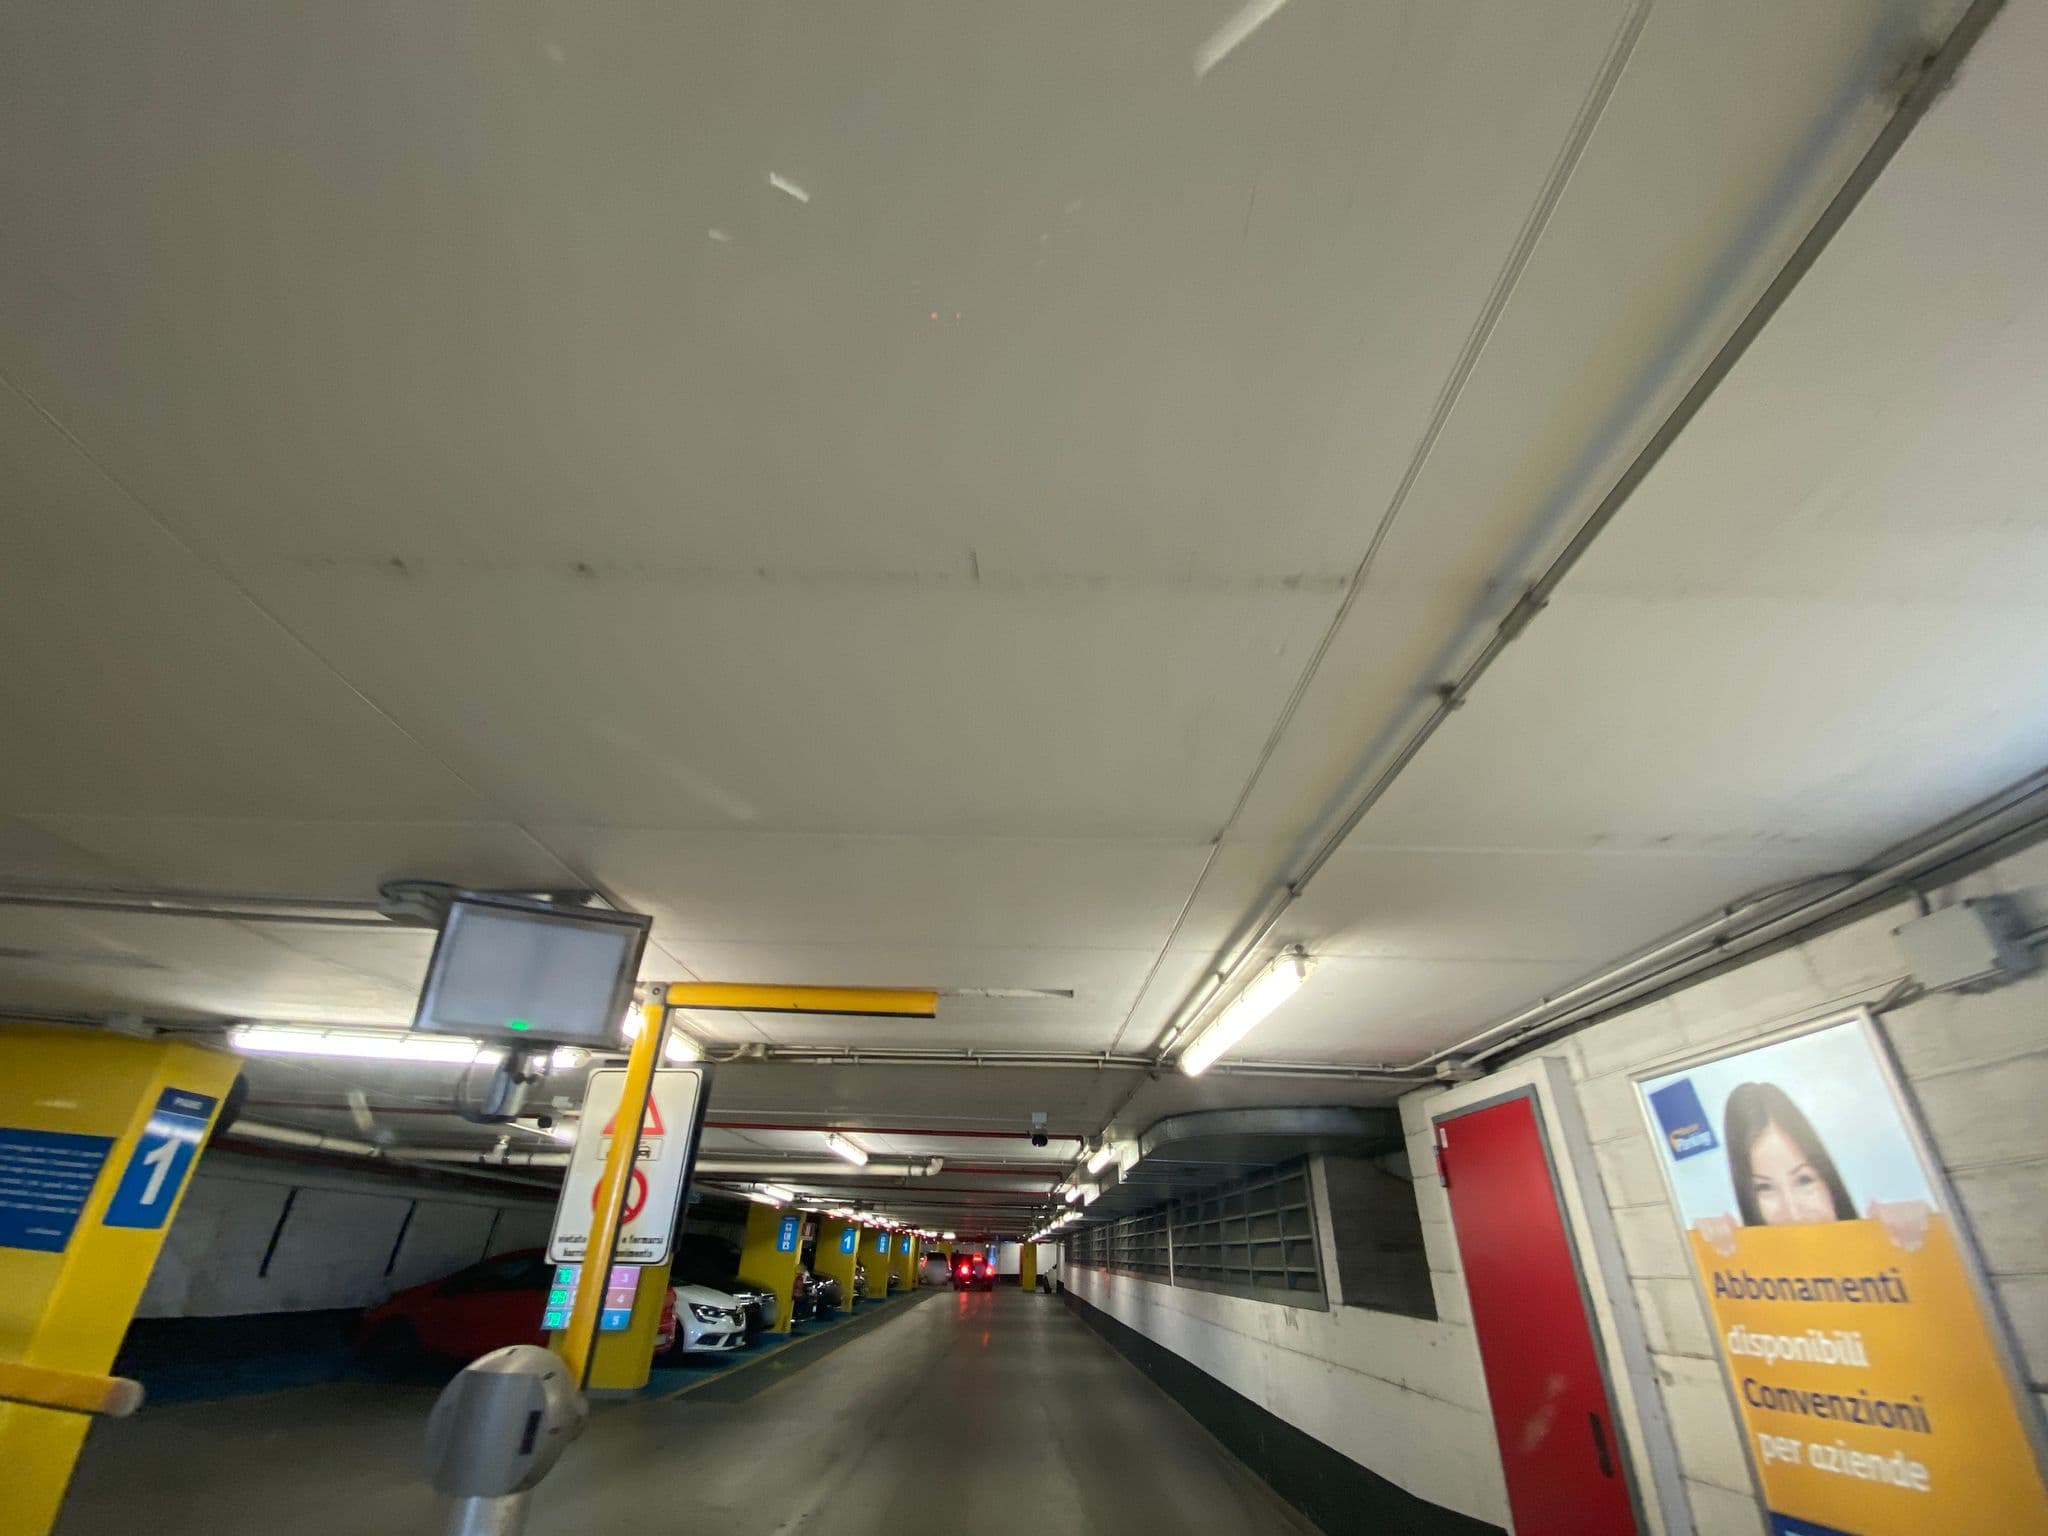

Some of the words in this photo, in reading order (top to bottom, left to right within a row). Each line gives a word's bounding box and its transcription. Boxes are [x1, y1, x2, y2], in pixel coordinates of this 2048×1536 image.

[139, 1136, 182, 1205] 1
[616, 1295, 624, 1304] 4
[1713, 1268, 1908, 1304] Abbonamenti
[612, 1315, 620, 1326] 5
[1727, 1324, 1869, 1367] disponibili
[1743, 1377, 1932, 1433] Convenzioni
[1759, 1432, 1802, 1464] per
[1807, 1439, 1931, 1492] aziende
